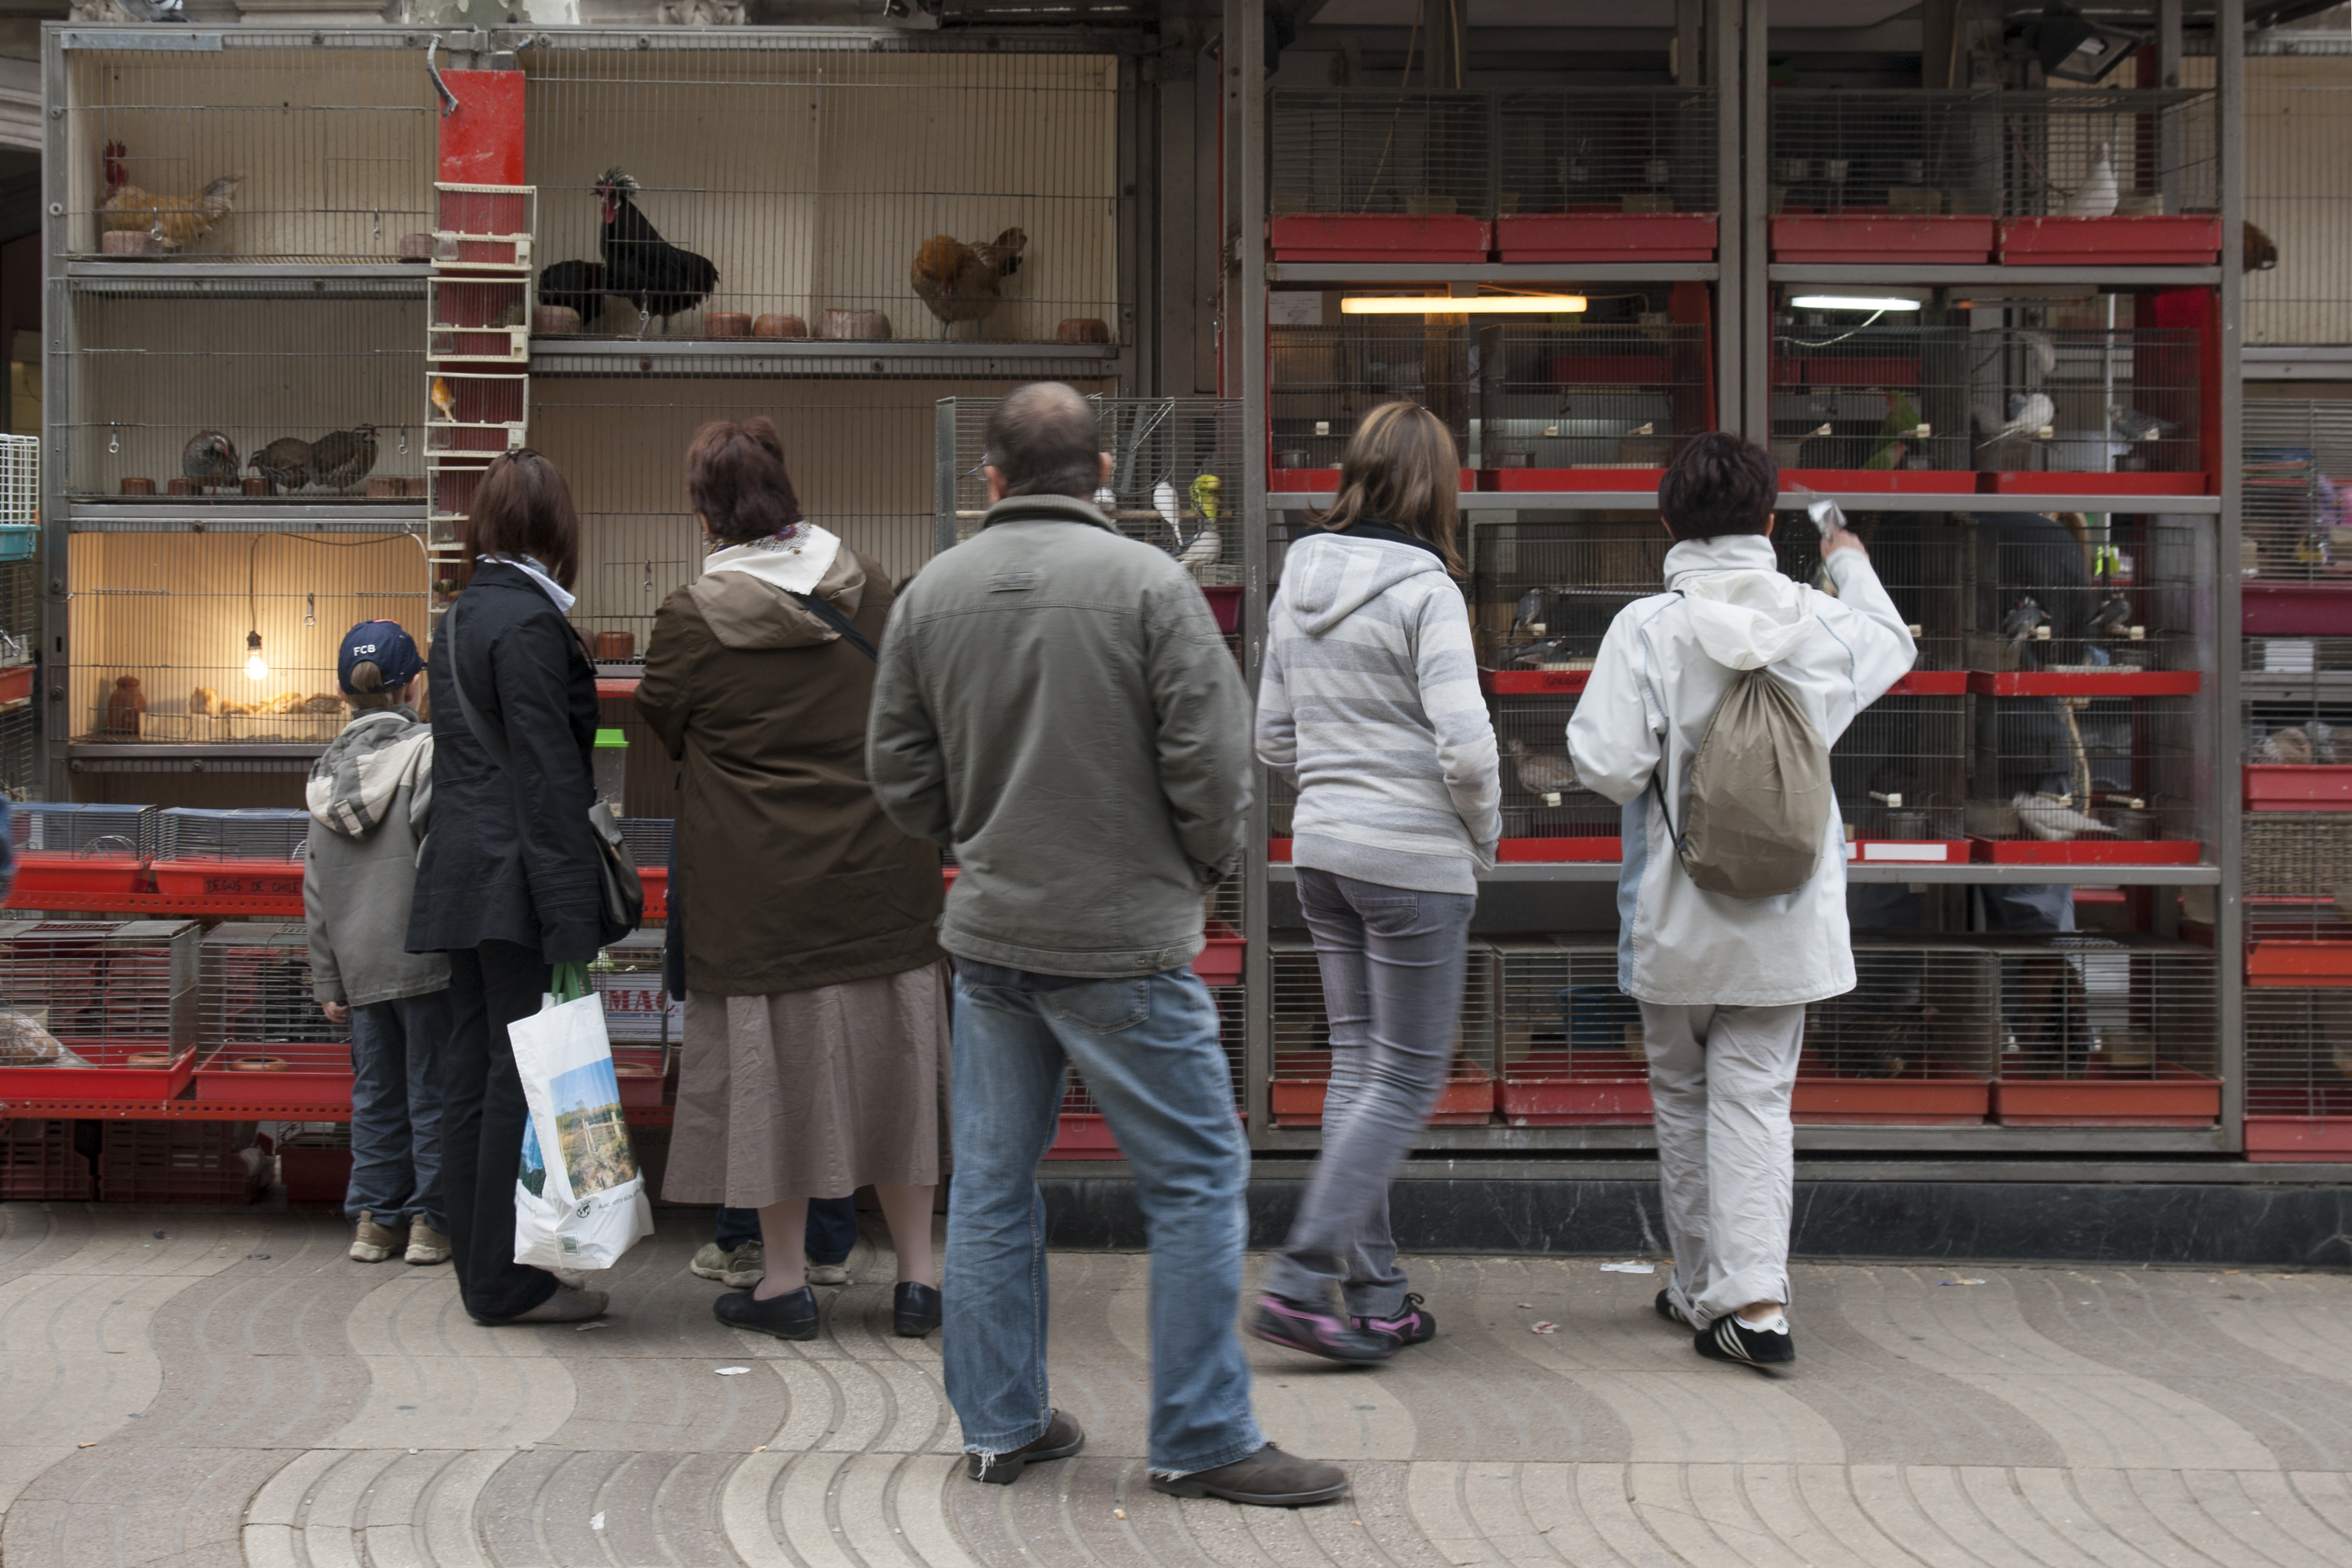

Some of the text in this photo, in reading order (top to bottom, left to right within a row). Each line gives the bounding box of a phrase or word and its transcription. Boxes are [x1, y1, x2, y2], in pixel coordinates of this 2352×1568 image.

[353, 644, 376, 657] FCB
[206, 879, 242, 893] DEGUS
[250, 881, 264, 892] DE
